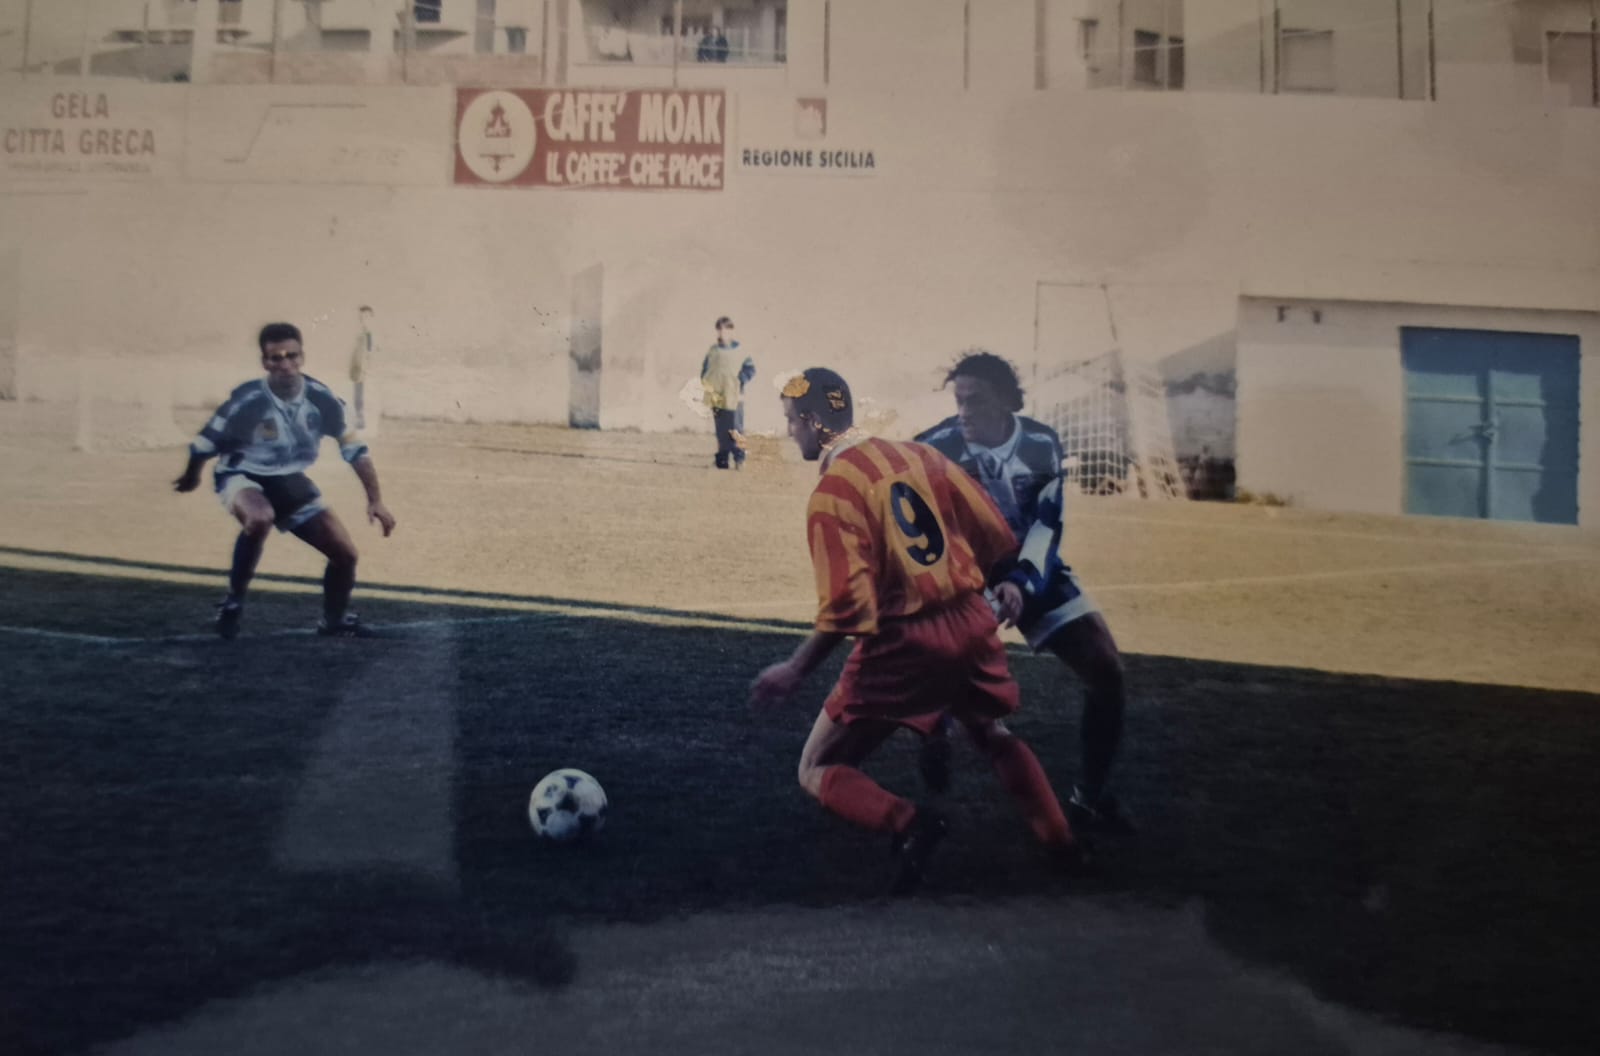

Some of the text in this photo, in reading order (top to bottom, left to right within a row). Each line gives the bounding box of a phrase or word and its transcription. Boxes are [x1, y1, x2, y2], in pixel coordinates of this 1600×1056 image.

[51, 92, 109, 119] GELA
[544, 91, 723, 145] CAFFE' MOAK
[4, 128, 156, 155] CITTA GRECA
[545, 151, 723, 188] IL CAFFE' CHE PIACE
[742, 149, 876, 169] REGIONE SICILIA
[890, 481, 945, 567] 9
